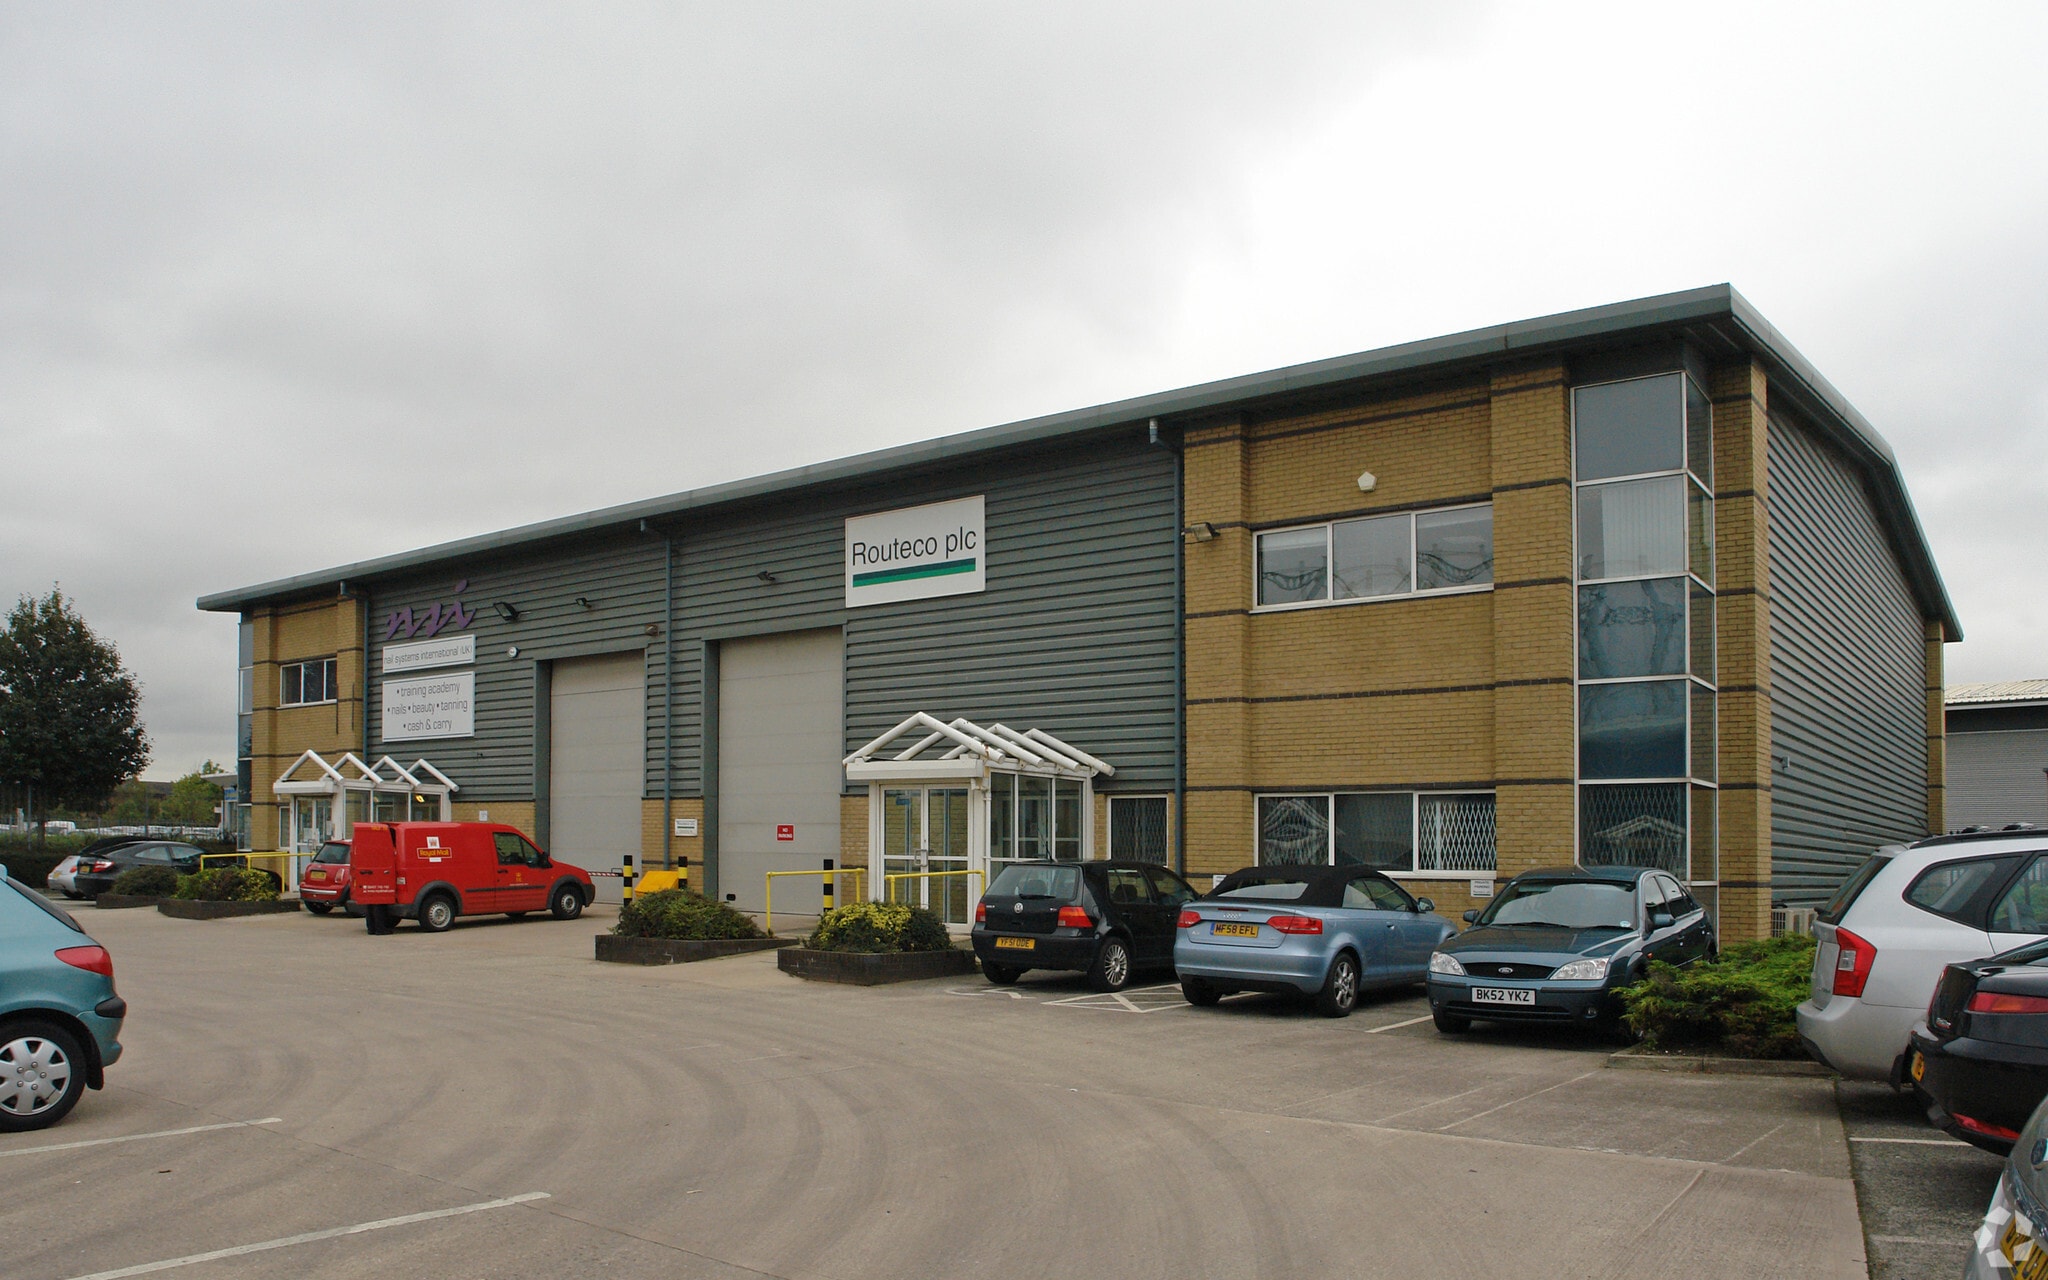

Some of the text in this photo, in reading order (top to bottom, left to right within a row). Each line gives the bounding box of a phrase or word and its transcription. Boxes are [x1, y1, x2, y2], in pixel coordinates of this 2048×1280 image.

[852, 526, 977, 566] Routeco plc
[384, 655, 394, 665] nail
[395, 652, 420, 666] systems
[421, 645, 459, 660] international
[400, 682, 460, 698] training academy
[391, 700, 468, 715] nails beauty tanning
[407, 718, 452, 732] cash & carry
[420, 849, 436, 857] Royal
[1238, 926, 1256, 936] EFL
[1476, 988, 1530, 1002] BK52 YKZ
